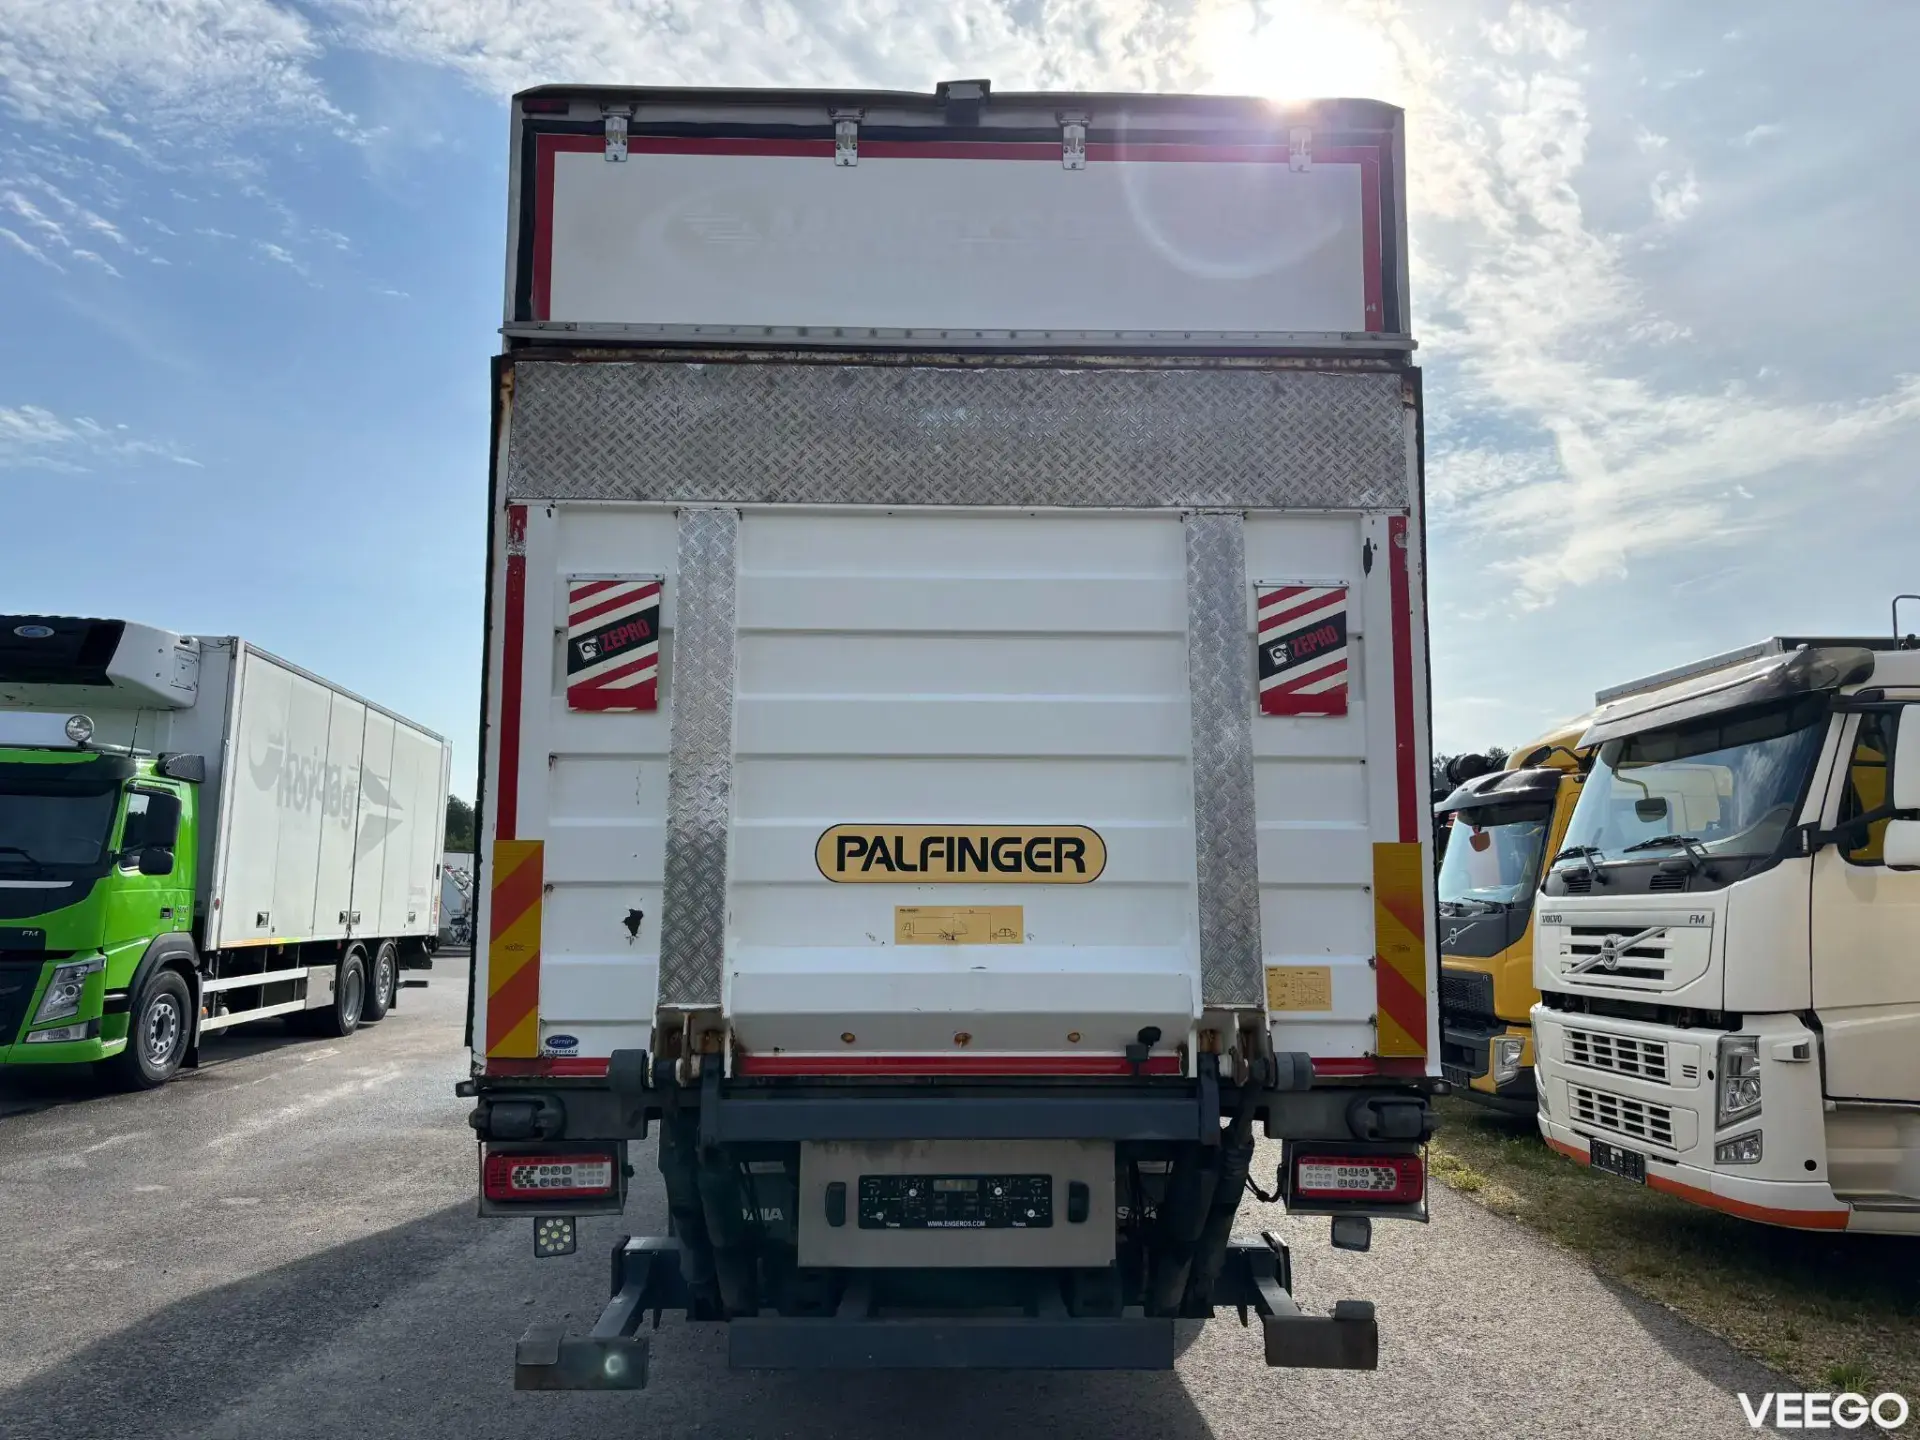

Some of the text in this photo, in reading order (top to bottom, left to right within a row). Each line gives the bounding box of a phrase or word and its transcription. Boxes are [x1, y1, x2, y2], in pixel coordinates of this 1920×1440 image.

[599, 619, 650, 652] ZEPRO
[1289, 625, 1338, 658] ZEPRO
[836, 835, 1086, 873] PALFINGER
[1542, 914, 1562, 923] VOLVO
[1689, 914, 1705, 924] FM
